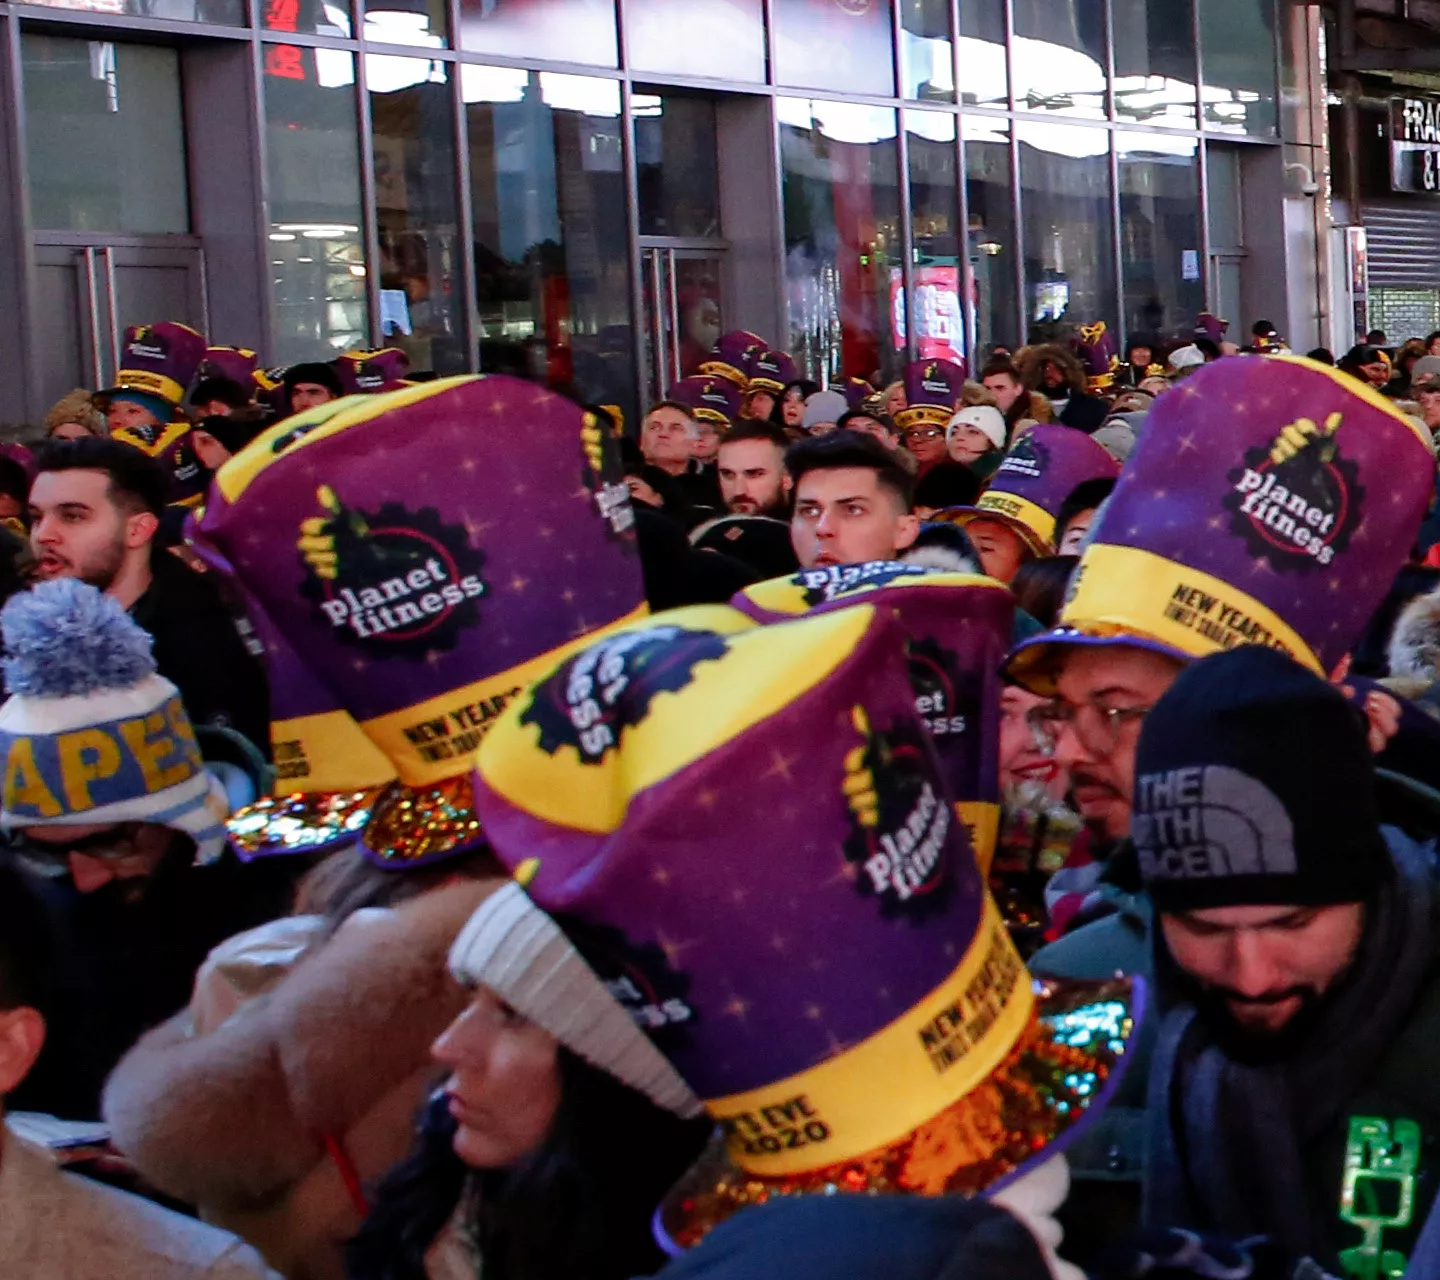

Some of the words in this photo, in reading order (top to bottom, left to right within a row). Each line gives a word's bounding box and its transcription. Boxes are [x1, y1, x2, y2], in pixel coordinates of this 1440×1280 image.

[1424, 151, 1435, 190] &
[1237, 468, 1334, 532] planet
[1240, 495, 1335, 564] fitness
[322, 558, 450, 625] planet
[350, 575, 486, 638] fitness
[1173, 582, 1217, 613] NEW
[404, 715, 449, 744] NEW
[1139, 766, 1203, 802] THE
[865, 781, 936, 894] planet
[893, 799, 950, 900] fitness
[743, 1121, 830, 1156] 2020
